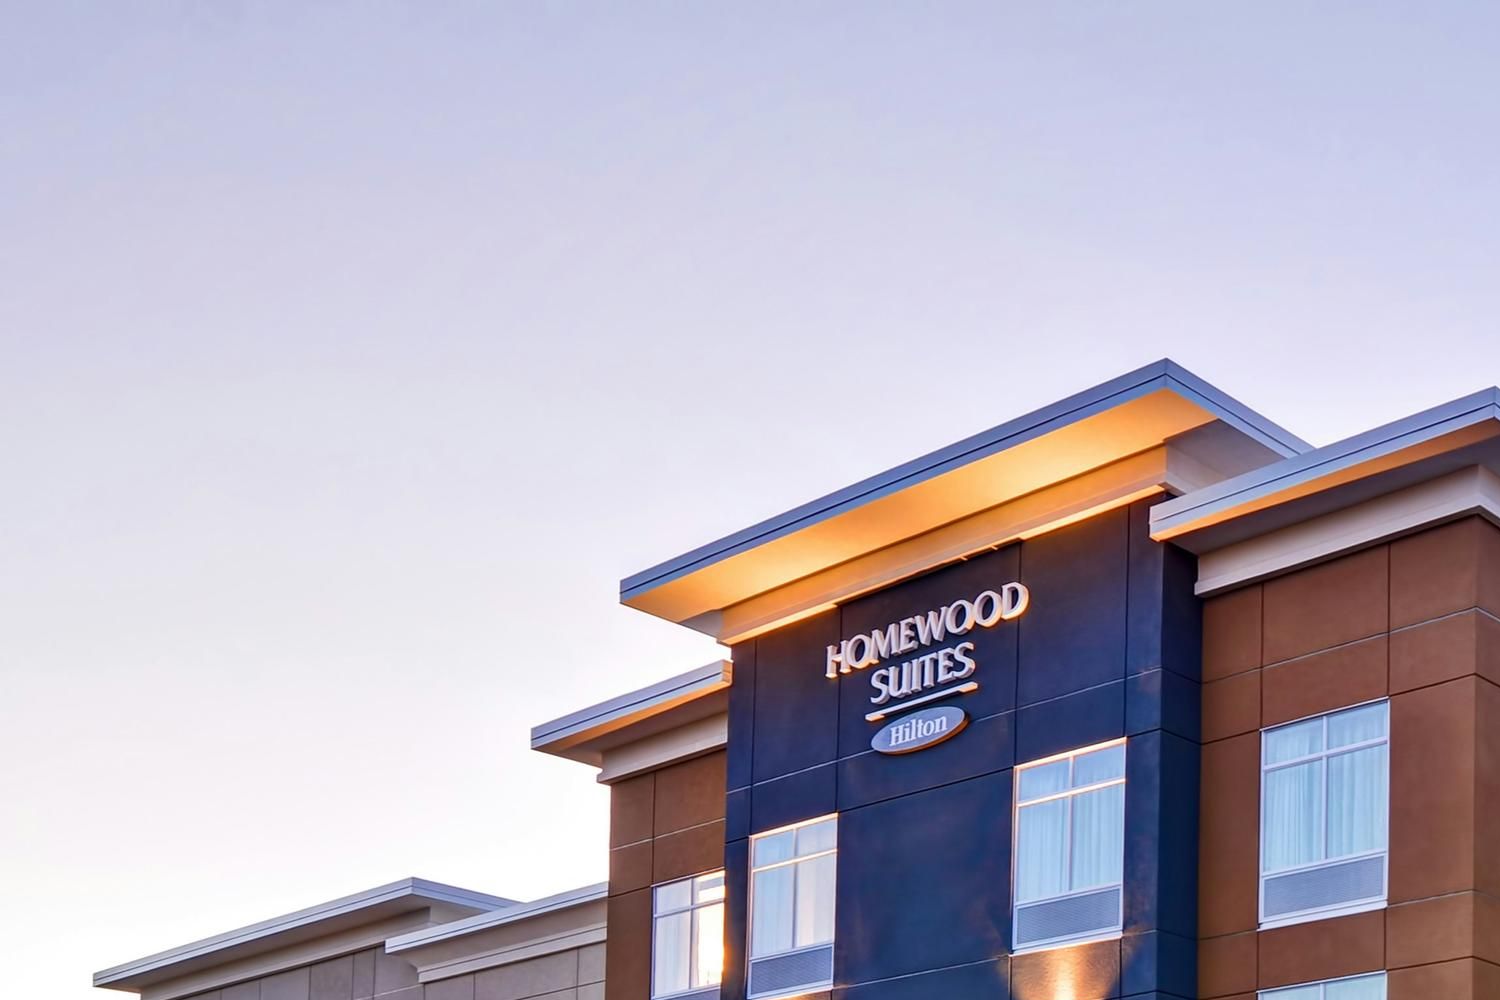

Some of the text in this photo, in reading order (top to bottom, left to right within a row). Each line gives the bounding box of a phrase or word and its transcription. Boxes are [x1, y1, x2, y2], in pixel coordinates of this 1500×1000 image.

[825, 581, 1029, 678] HOMEWOOD
[870, 641, 975, 704] SUITES
[888, 715, 948, 747] Hilton
